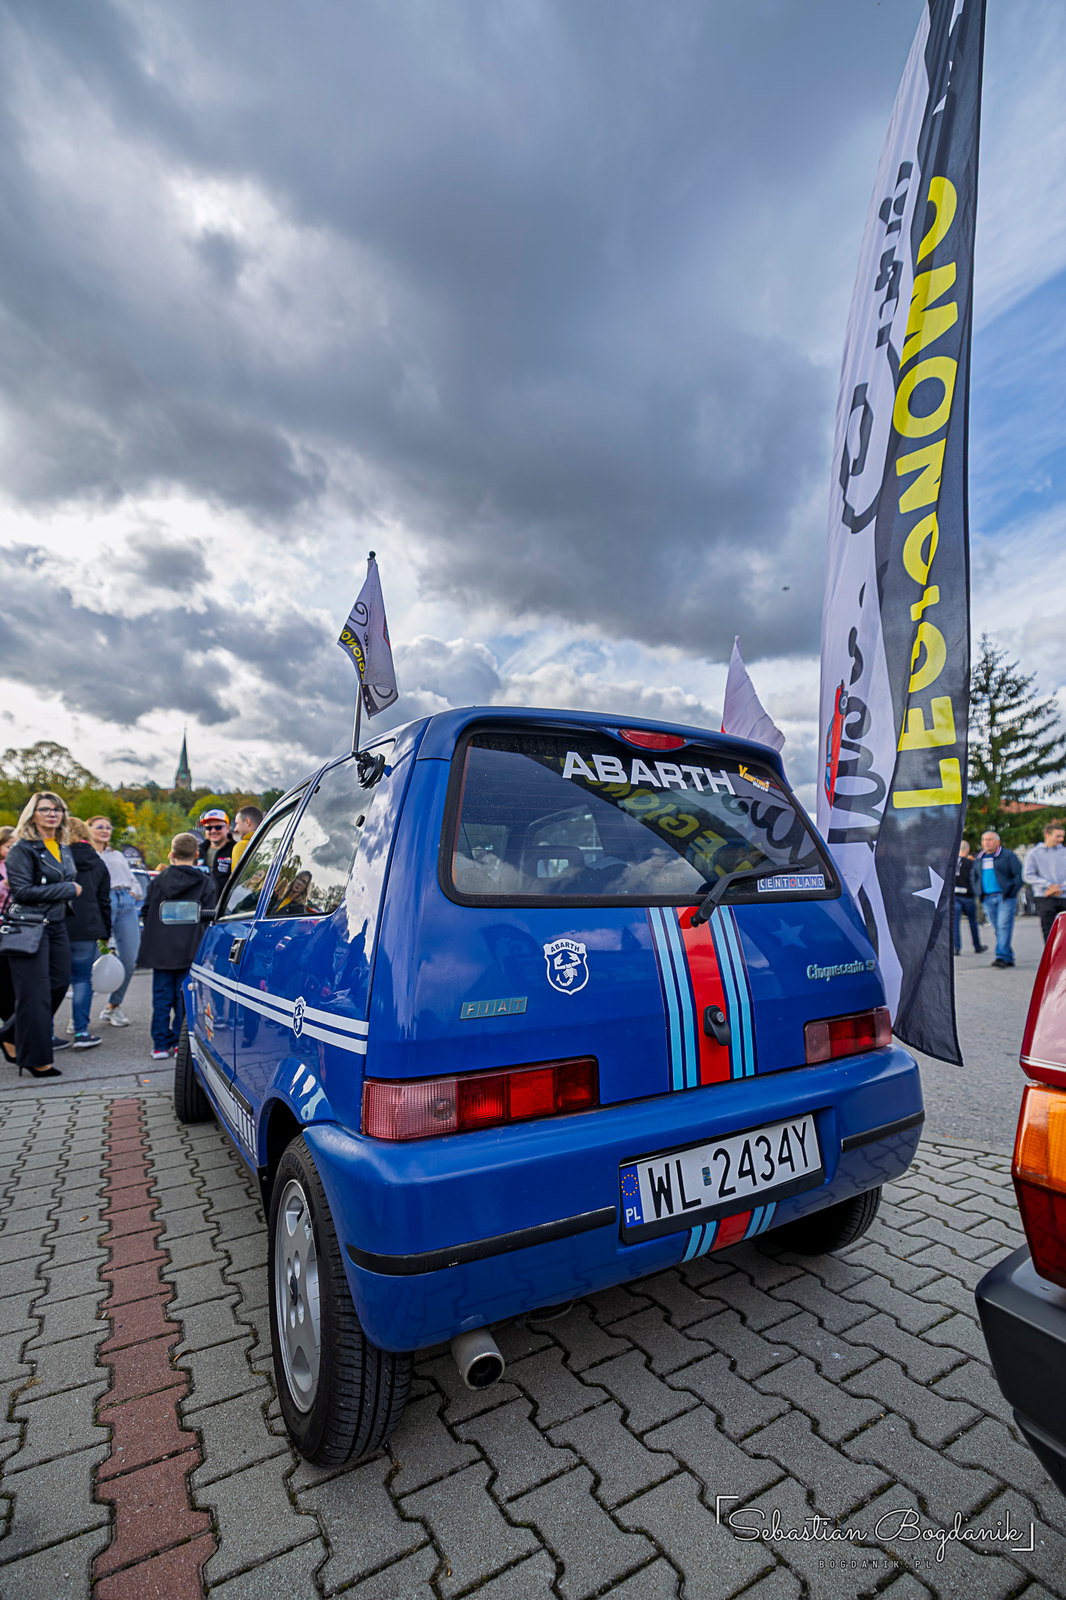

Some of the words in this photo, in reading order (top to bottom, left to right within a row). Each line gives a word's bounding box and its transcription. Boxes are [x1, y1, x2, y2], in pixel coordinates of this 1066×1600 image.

[562, 751, 736, 795] ABARTH
[760, 877, 824, 889] CENTOLAND
[550, 941, 580, 953] ABARTH
[806, 960, 864, 982] Cinquecento
[467, 999, 524, 1017] FIAT
[648, 1160, 702, 1219] WL
[712, 1121, 808, 1198] 2434Y
[625, 1207, 641, 1223] PL
